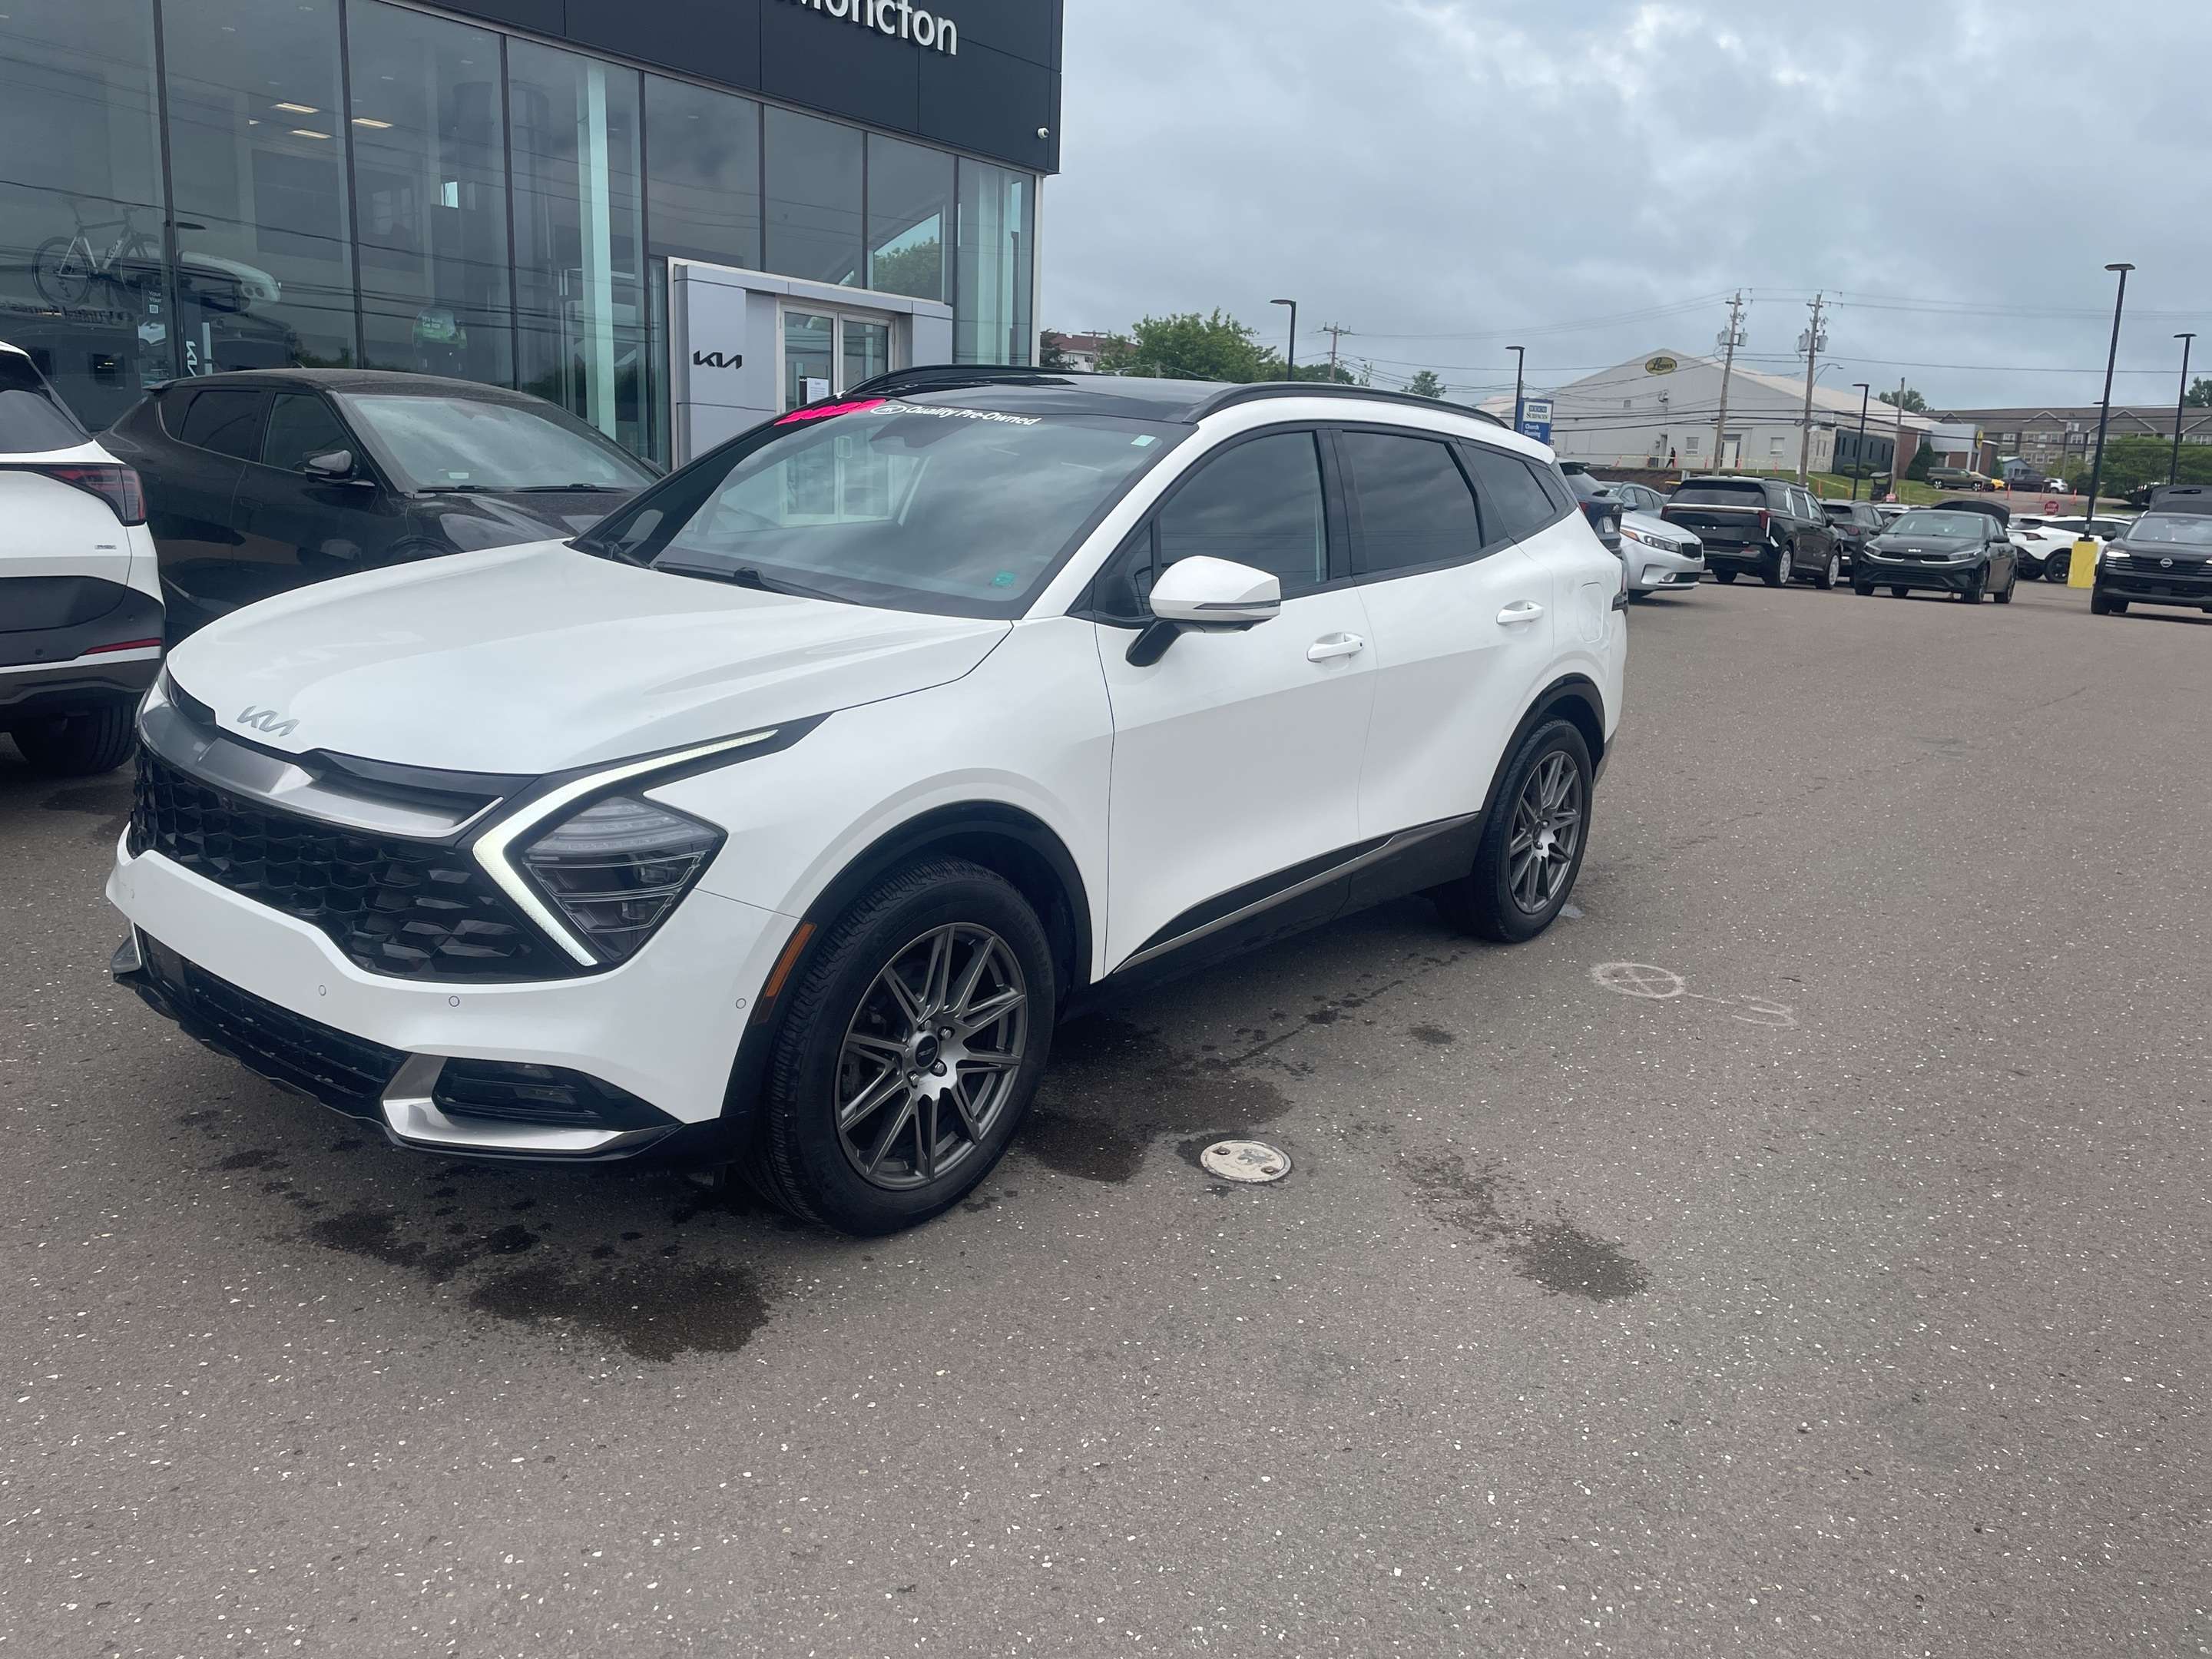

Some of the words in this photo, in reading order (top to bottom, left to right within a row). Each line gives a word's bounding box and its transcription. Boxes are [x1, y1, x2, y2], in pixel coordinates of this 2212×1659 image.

[694, 350, 743, 369] KIA
[906, 406, 959, 419] Quality
[955, 409, 1042, 426] Pre-Owned
[237, 706, 300, 737] KIA
